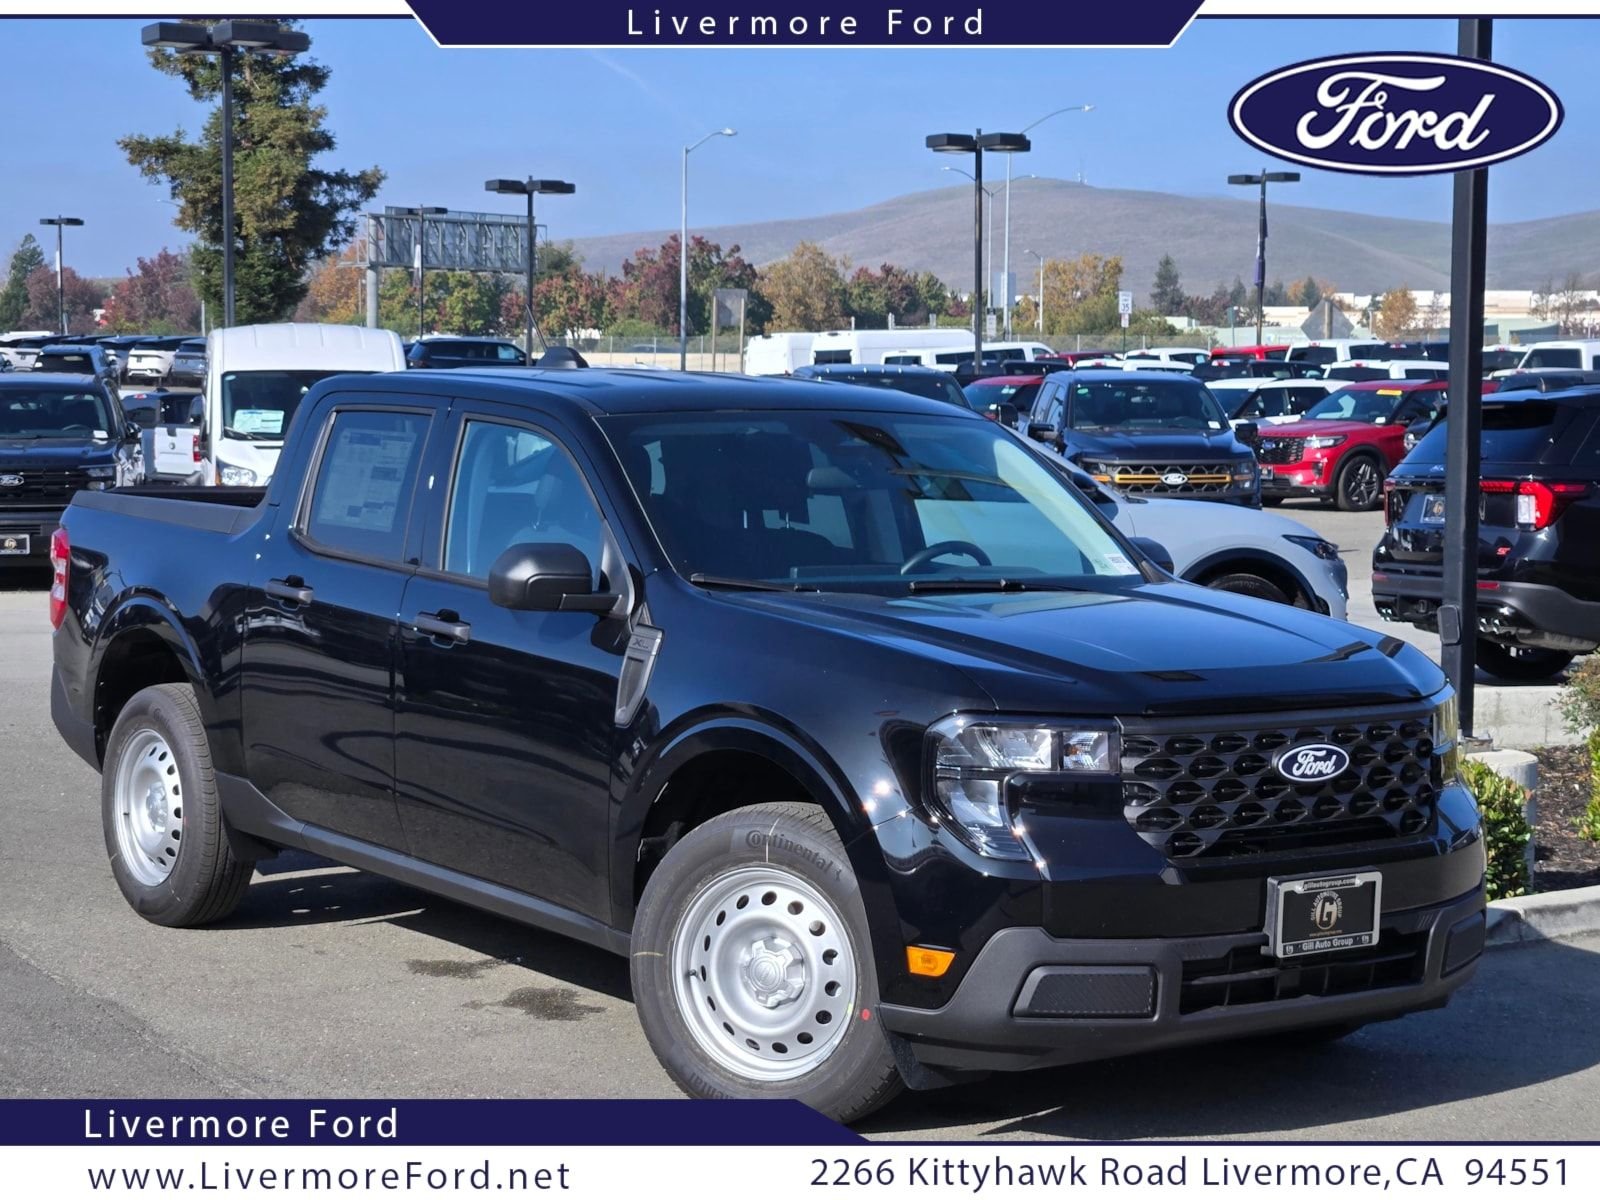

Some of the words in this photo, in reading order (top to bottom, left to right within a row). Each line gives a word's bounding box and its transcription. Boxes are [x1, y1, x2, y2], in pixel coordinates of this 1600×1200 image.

[1292, 750, 1337, 776] Ford
[745, 829, 834, 873] Continental
[1302, 941, 1315, 951] Gill
[1315, 940, 1332, 950] Auto
[1332, 937, 1354, 947] Group
